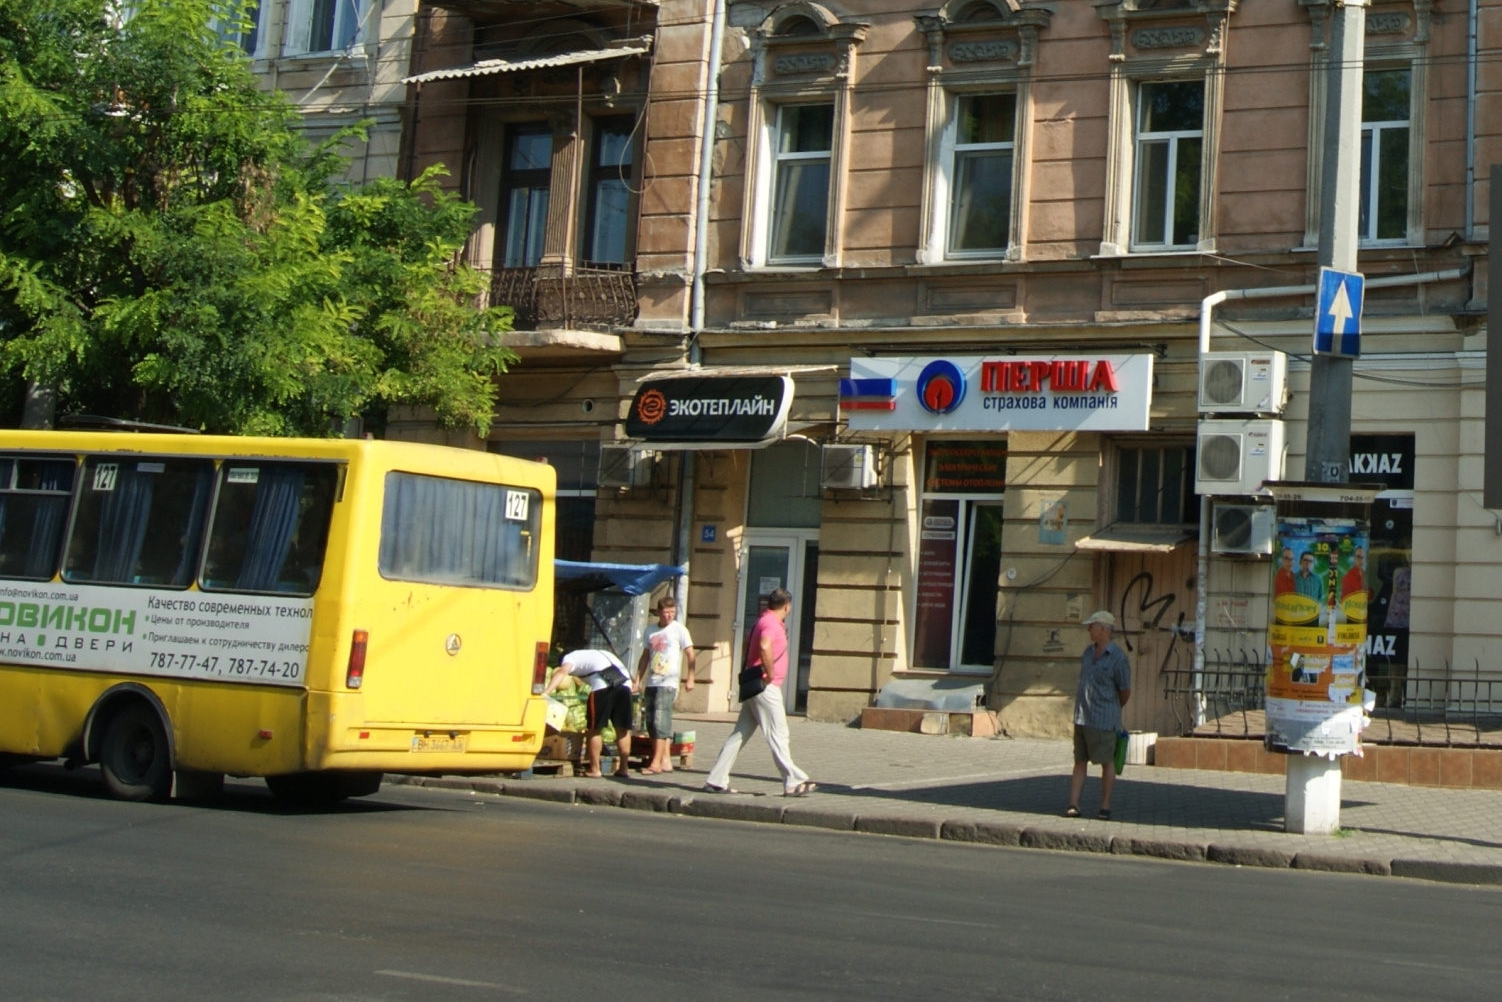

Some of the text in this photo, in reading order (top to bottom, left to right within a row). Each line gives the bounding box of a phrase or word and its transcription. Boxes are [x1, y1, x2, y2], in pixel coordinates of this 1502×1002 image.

[980, 360, 1119, 392] ПЕРША
[669, 395, 775, 416] ЭКОТЕПЛАЙН
[983, 394, 1117, 412] страхова компанія
[96, 464, 117, 489] 127
[509, 493, 526, 517] 127
[704, 529, 714, 538] 54
[0, 601, 137, 635] ОВИКОН
[148, 595, 313, 619] Качество современных технол
[150, 614, 250, 630] Цены от производителя
[55, 636, 133, 652] ДВЕРИ
[148, 632, 199, 645] Приглашаем
[201, 637, 207, 645] к
[208, 638, 276, 651] сотрудничеству
[150, 652, 300, 679] 787-77-47, 787-74-20
